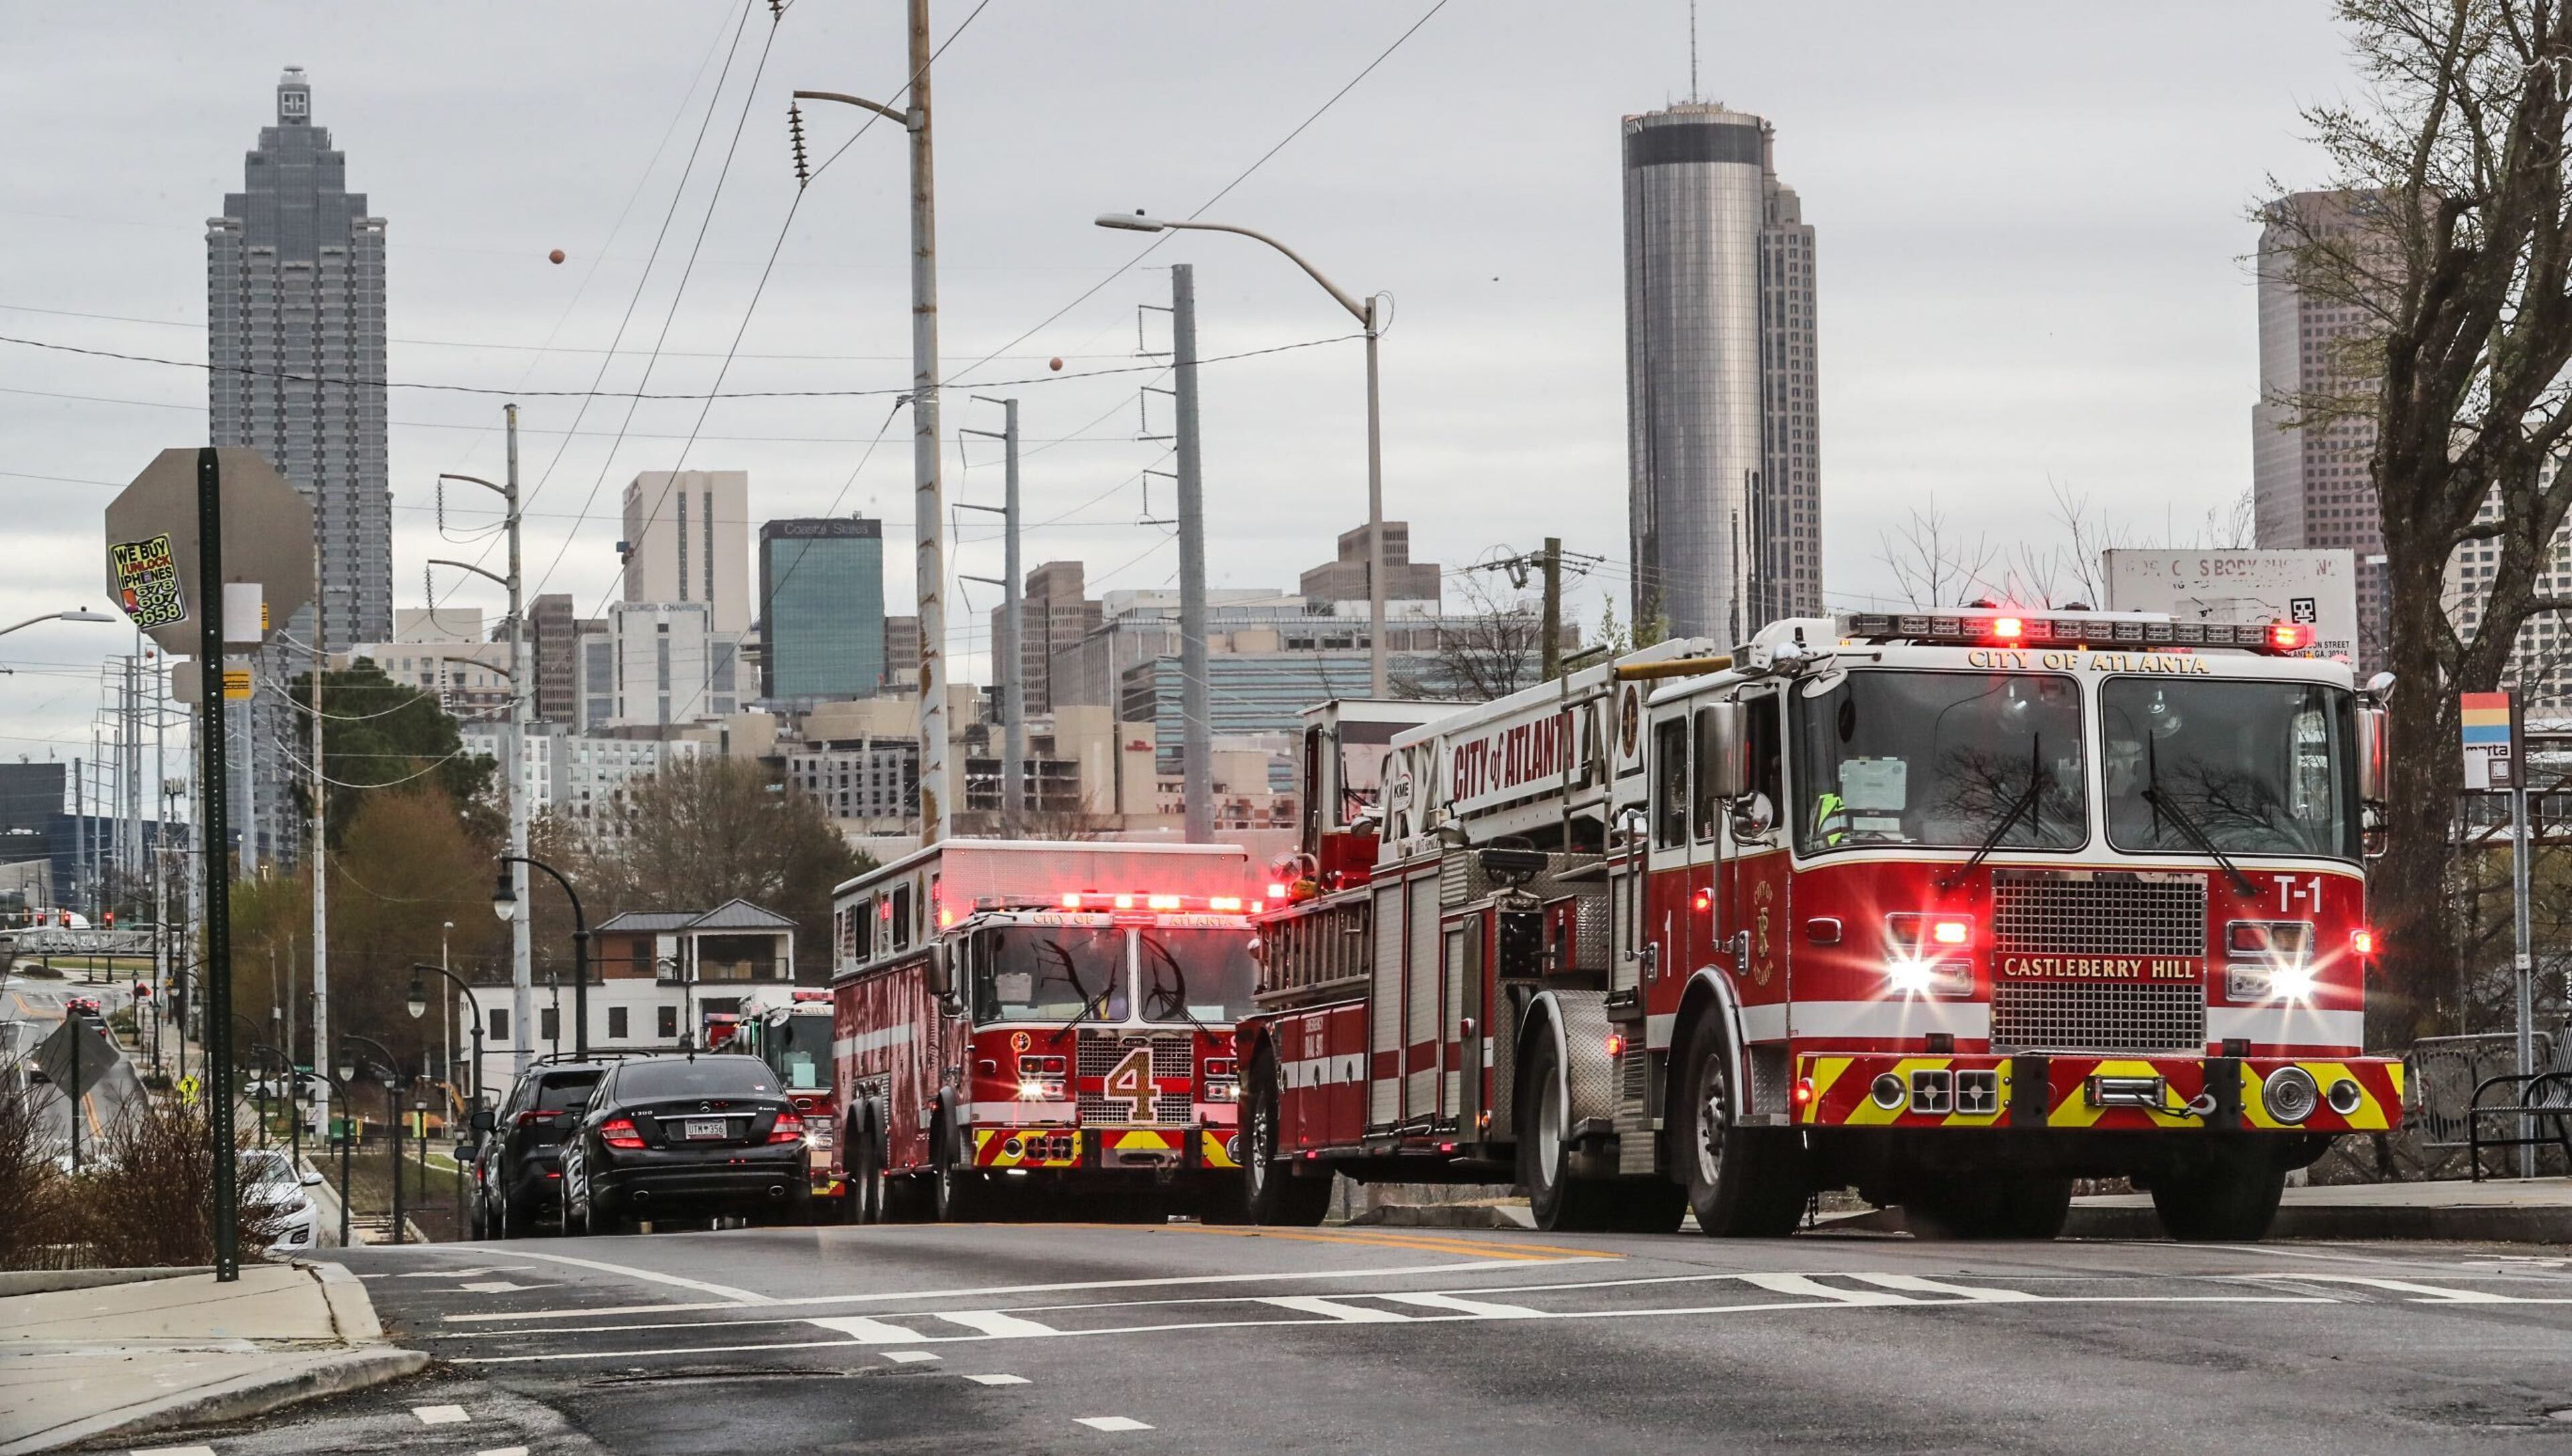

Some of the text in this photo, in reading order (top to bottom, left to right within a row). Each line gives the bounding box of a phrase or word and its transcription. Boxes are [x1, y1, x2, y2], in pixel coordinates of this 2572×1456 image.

[833, 523, 869, 534] States
[115, 540, 165, 565] WE BUY
[121, 567, 173, 589] IPHNES
[135, 579, 175, 597] 678
[137, 590, 177, 608] 607
[622, 603, 660, 612] GEORGIA
[131, 602, 181, 626] 5658
[2324, 641, 2350, 649] STREET
[1968, 650, 2210, 674] CITY OF ATLANTA
[1453, 737, 1490, 803] CITY
[1490, 732, 1504, 792] of
[1394, 782, 1409, 799] KME
[2273, 875, 2321, 914] T-1
[1033, 914, 1234, 927] CITY OF ATLANTA
[1664, 910, 1672, 978] 1
[2004, 958, 2195, 978] CASTLEBERRY HILL
[1104, 1047, 1162, 1124] 4
